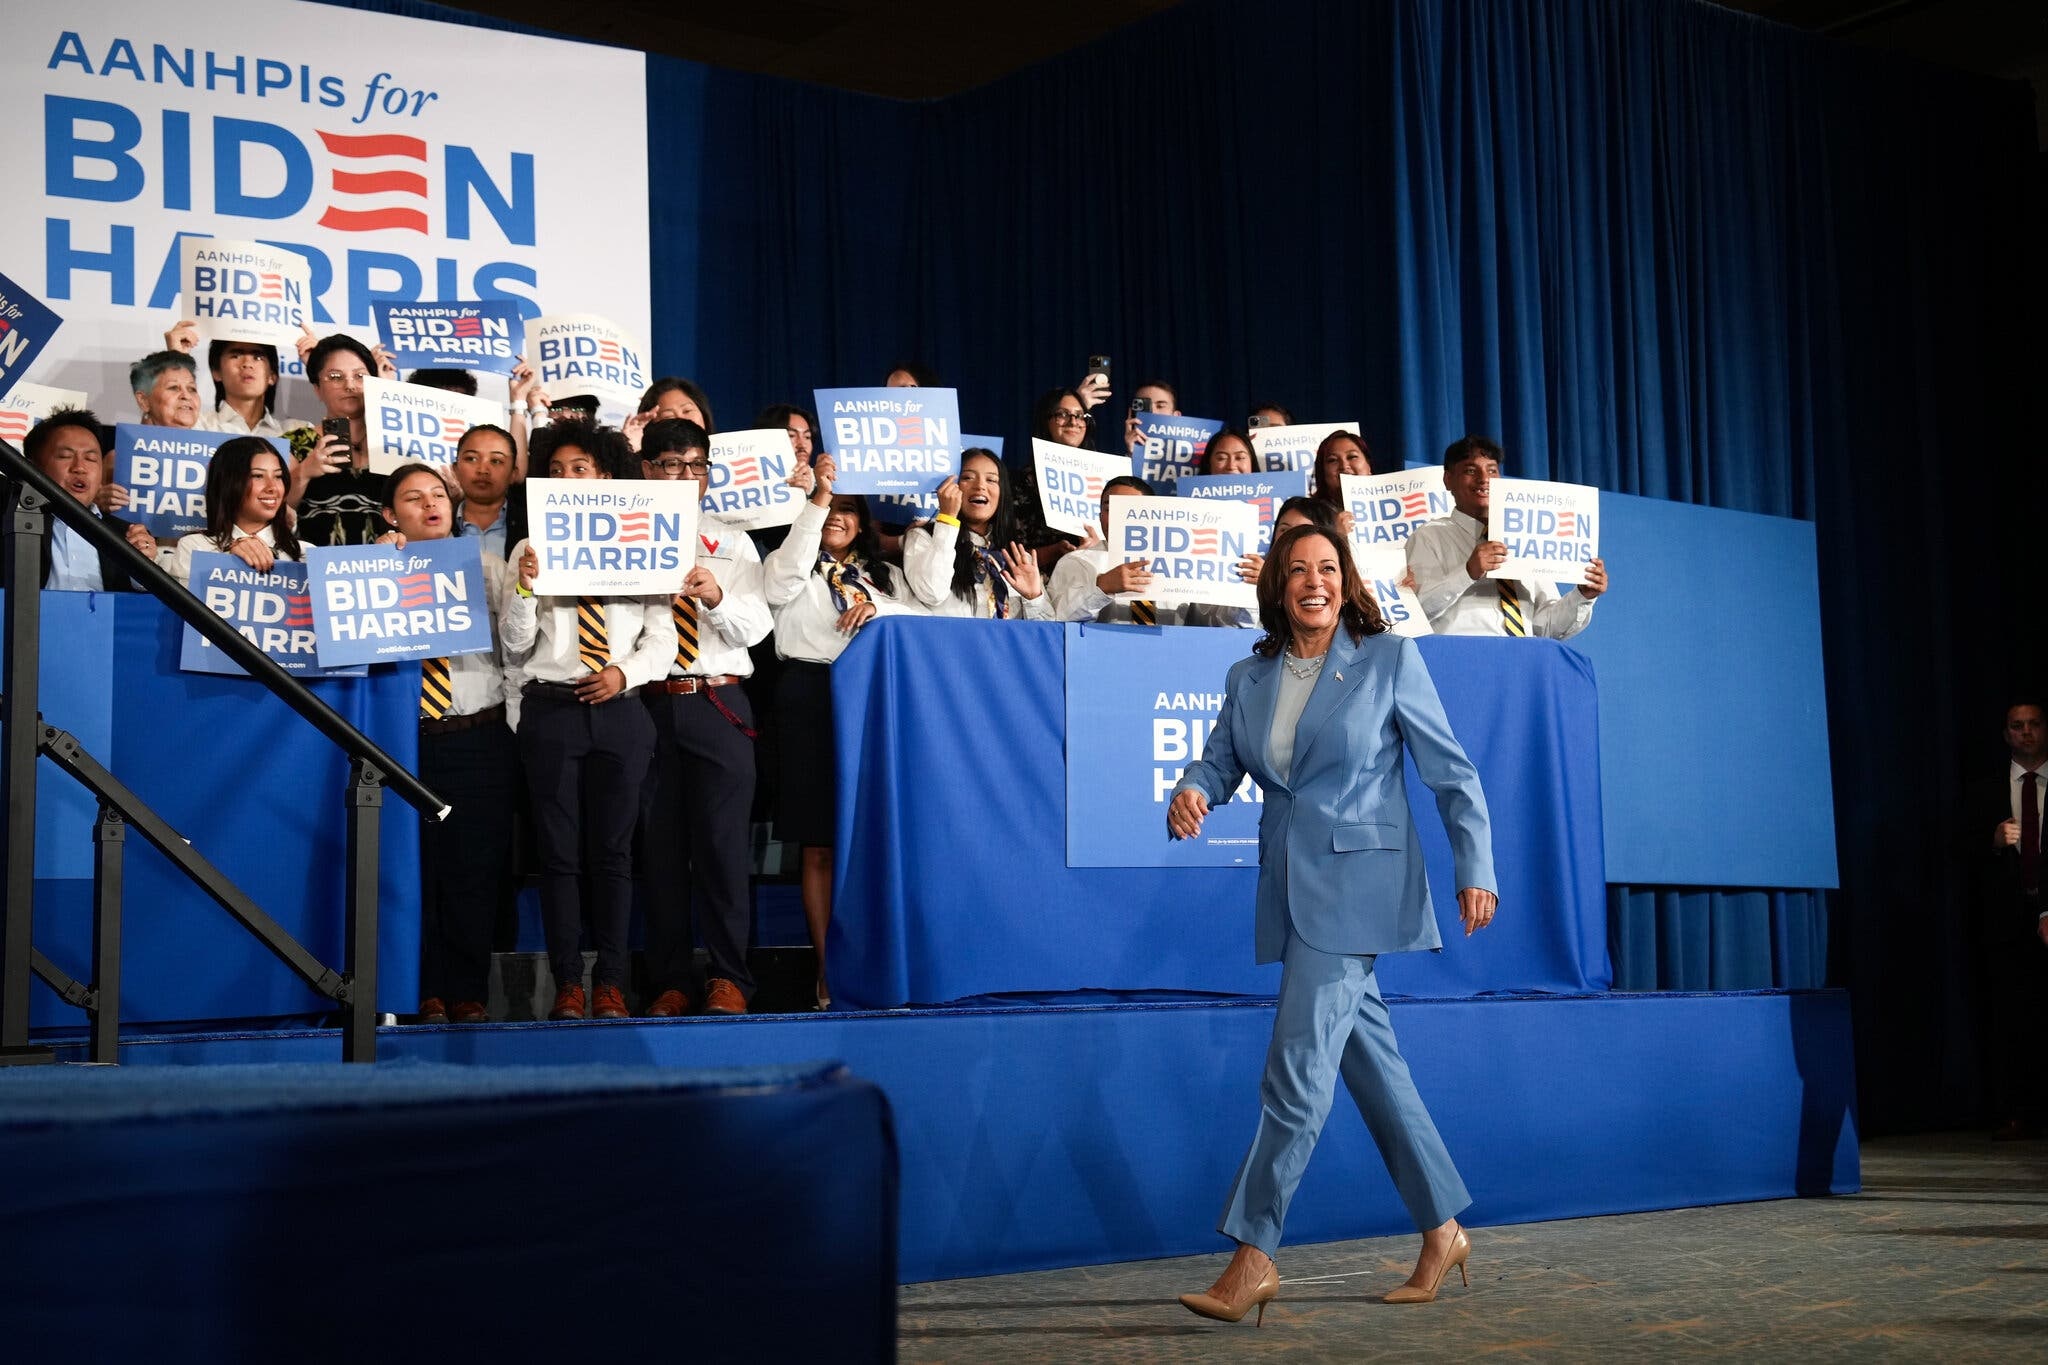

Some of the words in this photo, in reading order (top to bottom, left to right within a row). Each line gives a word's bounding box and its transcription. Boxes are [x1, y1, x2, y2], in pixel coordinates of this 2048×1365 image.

[47, 31, 346, 107] AANHPIs
[353, 73, 438, 123] for
[44, 93, 536, 247] BIDEN
[196, 250, 265, 268] AANHPIs
[265, 258, 283, 272] for
[195, 266, 301, 305] BIDEN
[195, 296, 303, 328] HARRIS
[389, 308, 458, 317] AANHPIs
[459, 307, 480, 319] for
[389, 317, 510, 338] BIDEN
[540, 323, 602, 337] AANHPIs
[393, 335, 512, 358] HARRIS
[539, 336, 641, 370] BIDEN
[542, 361, 644, 389] HARRIS
[8, 394, 35, 409] for
[381, 391, 446, 413] AANHPIs
[833, 400, 902, 413] AANHPIs
[903, 400, 923, 416] for
[834, 416, 948, 446] BIDEN
[1147, 423, 1199, 439] AANHPIs
[1199, 429, 1212, 441] for
[1264, 435, 1317, 448] AANHPIs
[839, 448, 950, 473] HARRIS
[700, 482, 791, 514] ARRIS
[1191, 485, 1254, 498] AANHPIs
[1253, 483, 1274, 497] for
[1351, 483, 1405, 496] AANHPIs
[1407, 480, 1425, 494] for
[1505, 492, 1563, 506] AANHPIs
[546, 494, 627, 507] AANHPIs
[628, 493, 654, 511] for
[1351, 491, 1449, 523] BIDEN
[545, 512, 680, 543] BIDEN
[1126, 509, 1199, 523] AANHPIs
[1200, 512, 1222, 526] for
[1504, 507, 1591, 538] BIDEN
[1124, 525, 1244, 558] BIDEN
[1504, 537, 1591, 563] HARRIS
[325, 558, 404, 575] AANHPIs
[405, 555, 432, 575] for
[546, 547, 680, 570] HARRIS
[209, 567, 298, 590] AANHPIs
[325, 570, 467, 612] BIDEN
[329, 605, 472, 641] HARRIS
[376, 643, 430, 654] JoeBiden.com
